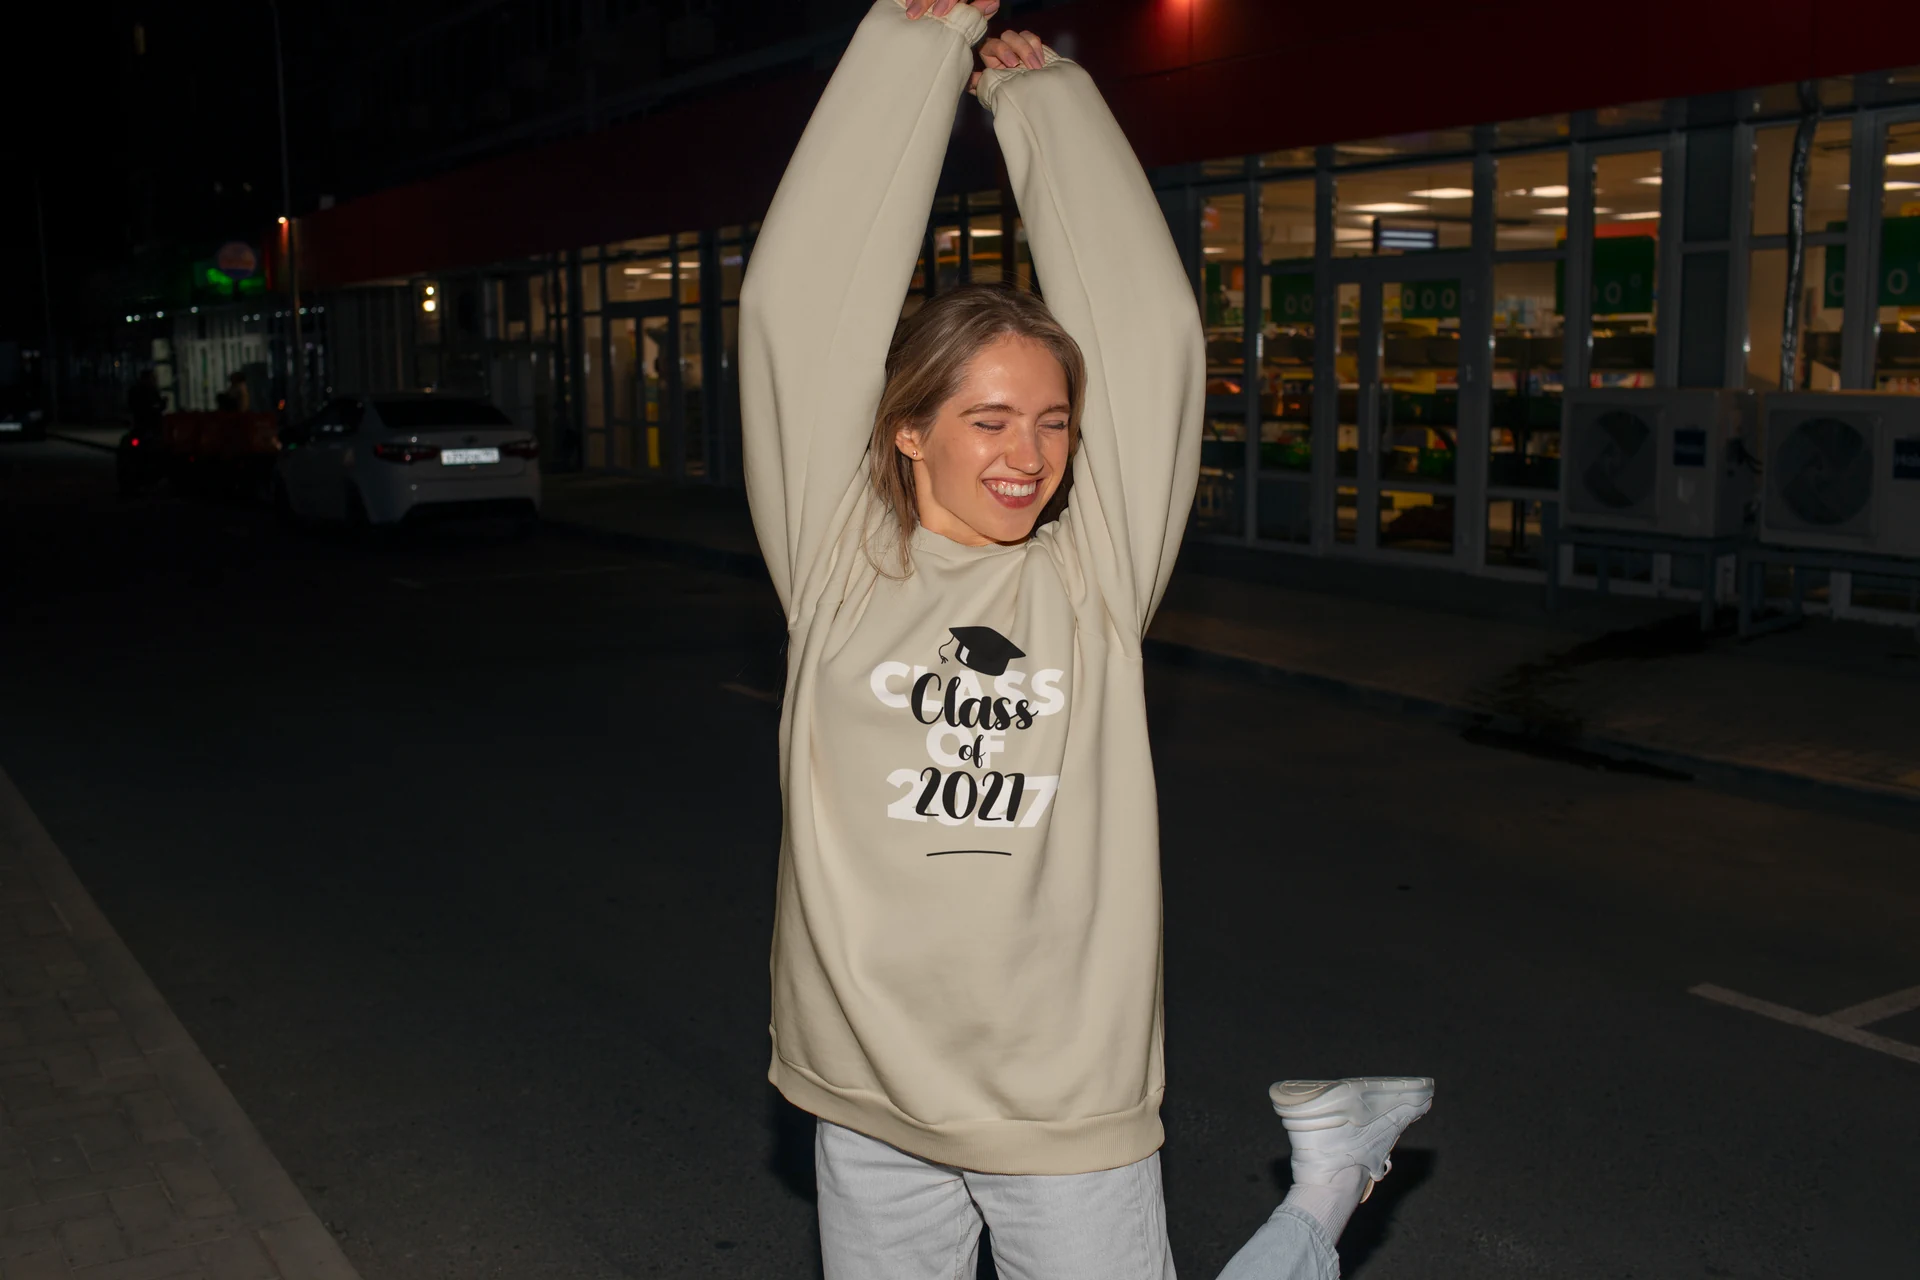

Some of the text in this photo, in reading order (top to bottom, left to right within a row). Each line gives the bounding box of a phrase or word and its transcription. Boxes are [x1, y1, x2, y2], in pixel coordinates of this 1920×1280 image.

[870, 661, 1065, 717] CLASS
[911, 672, 1039, 731] Class
[926, 720, 1006, 769] OF
[958, 734, 986, 769] of
[915, 767, 1025, 822] 2027
